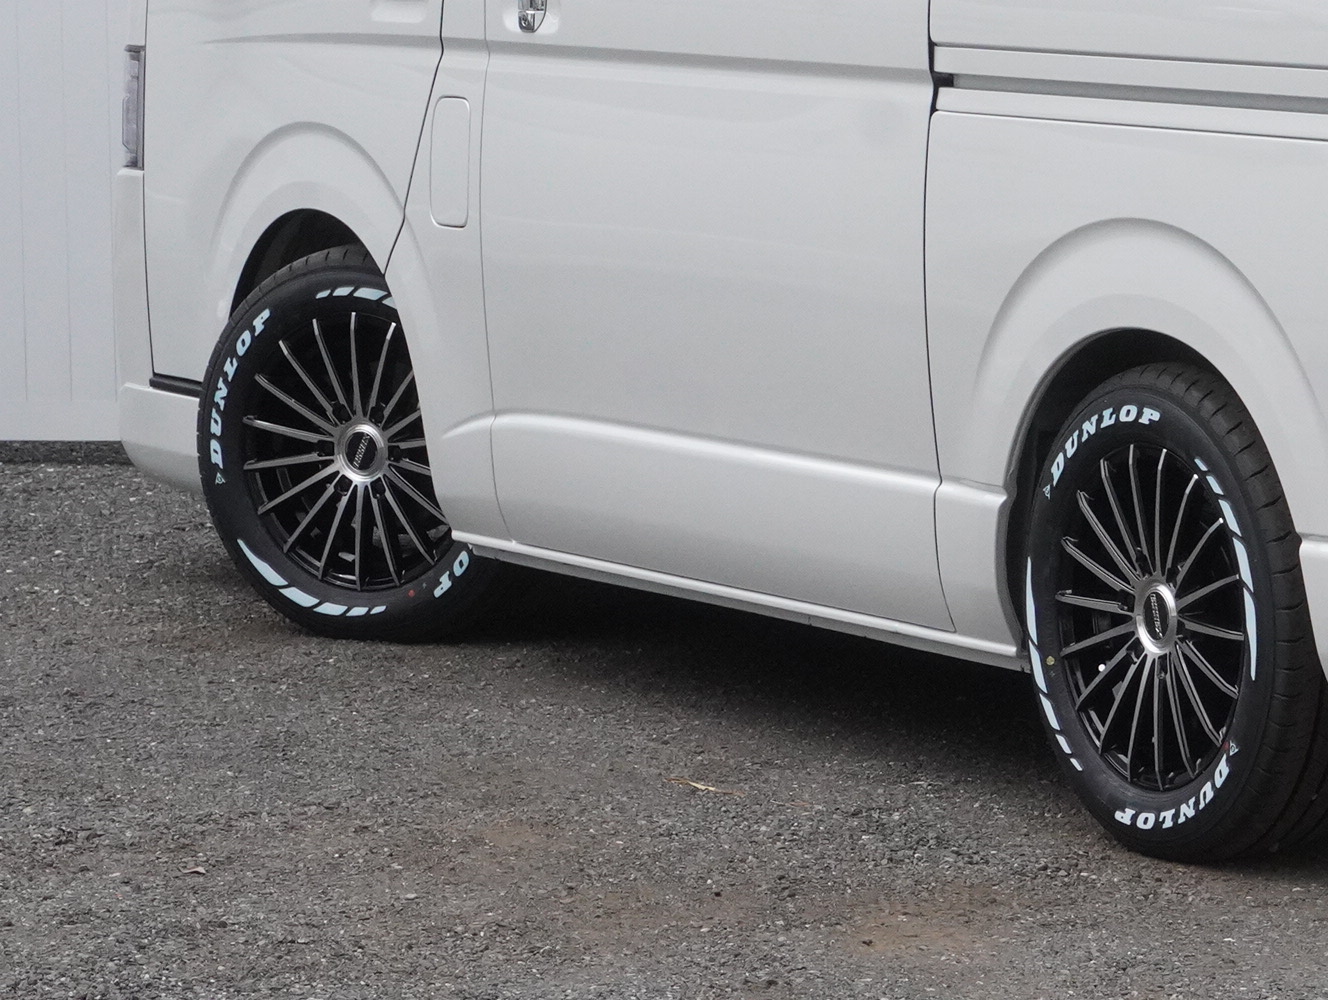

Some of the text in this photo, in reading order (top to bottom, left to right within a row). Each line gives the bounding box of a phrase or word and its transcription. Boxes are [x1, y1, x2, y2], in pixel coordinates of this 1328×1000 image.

[209, 308, 271, 470] DUNLOP
[1050, 404, 1161, 486] DUNLOP
[1114, 755, 1230, 830] DUNLOP
